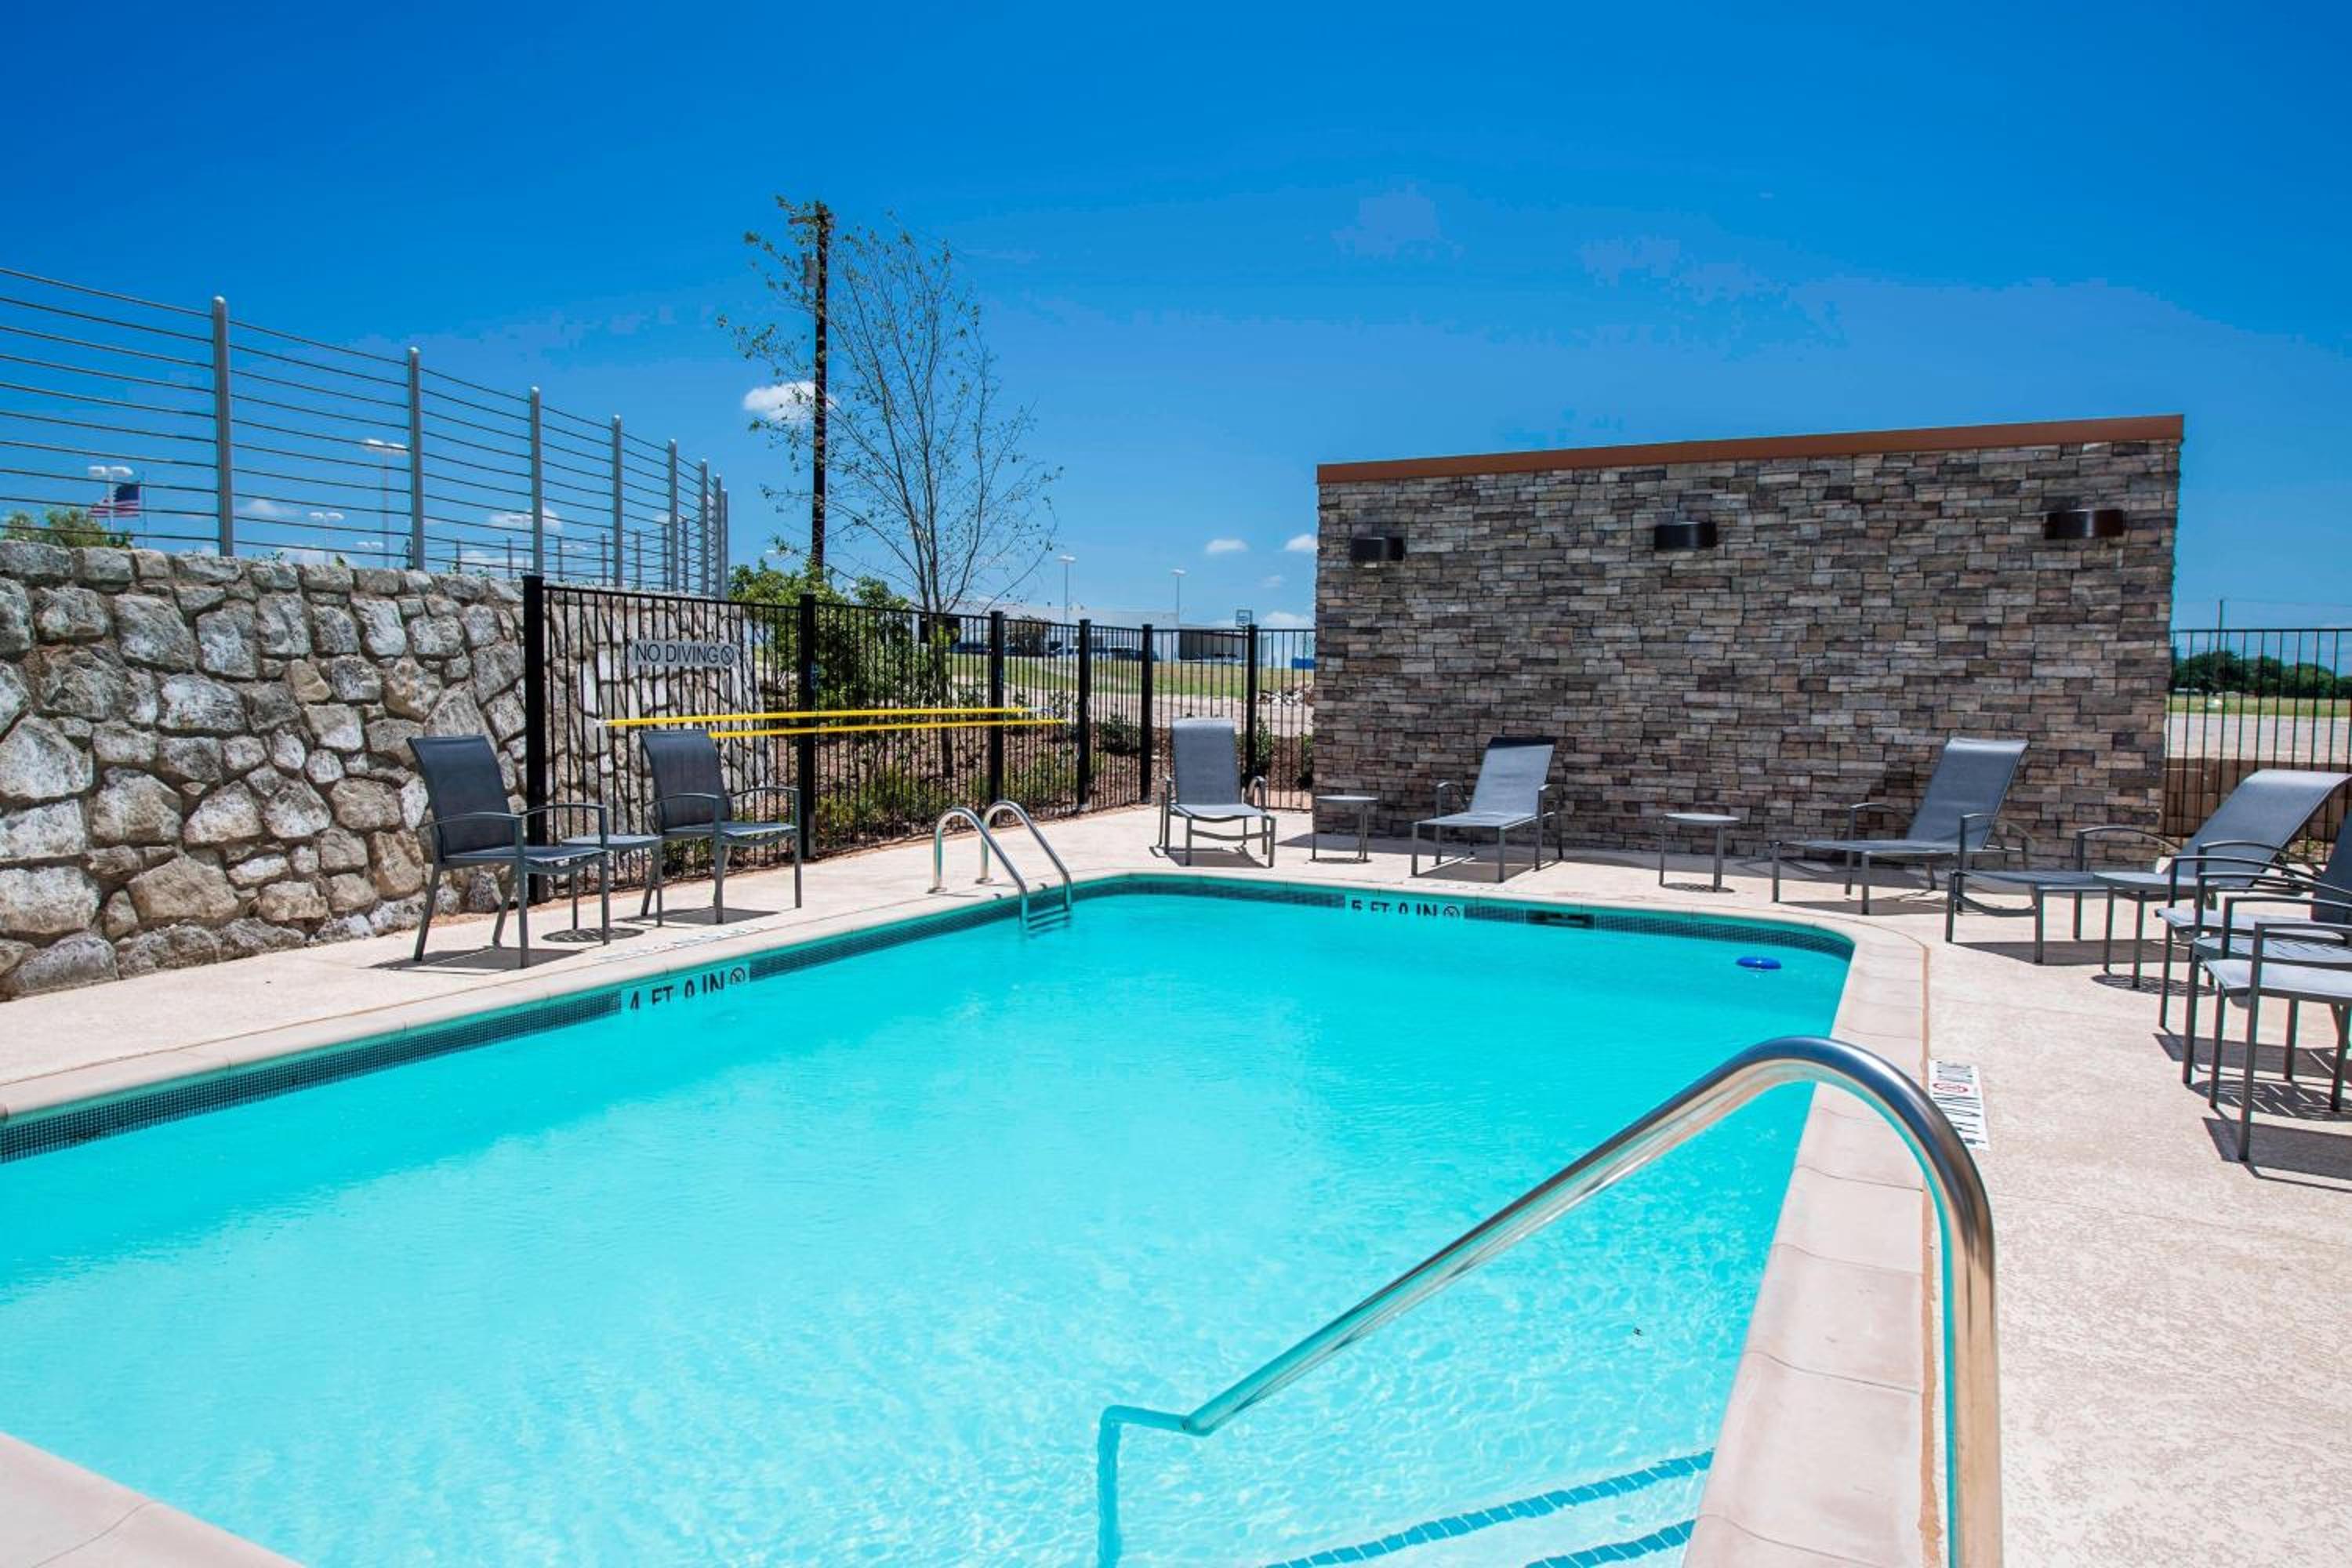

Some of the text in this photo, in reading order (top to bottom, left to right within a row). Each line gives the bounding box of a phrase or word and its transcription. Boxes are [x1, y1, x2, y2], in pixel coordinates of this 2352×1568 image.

[635, 643, 719, 664] NO DIVING
[652, 985, 674, 1005] FT
[702, 971, 725, 994] IN
